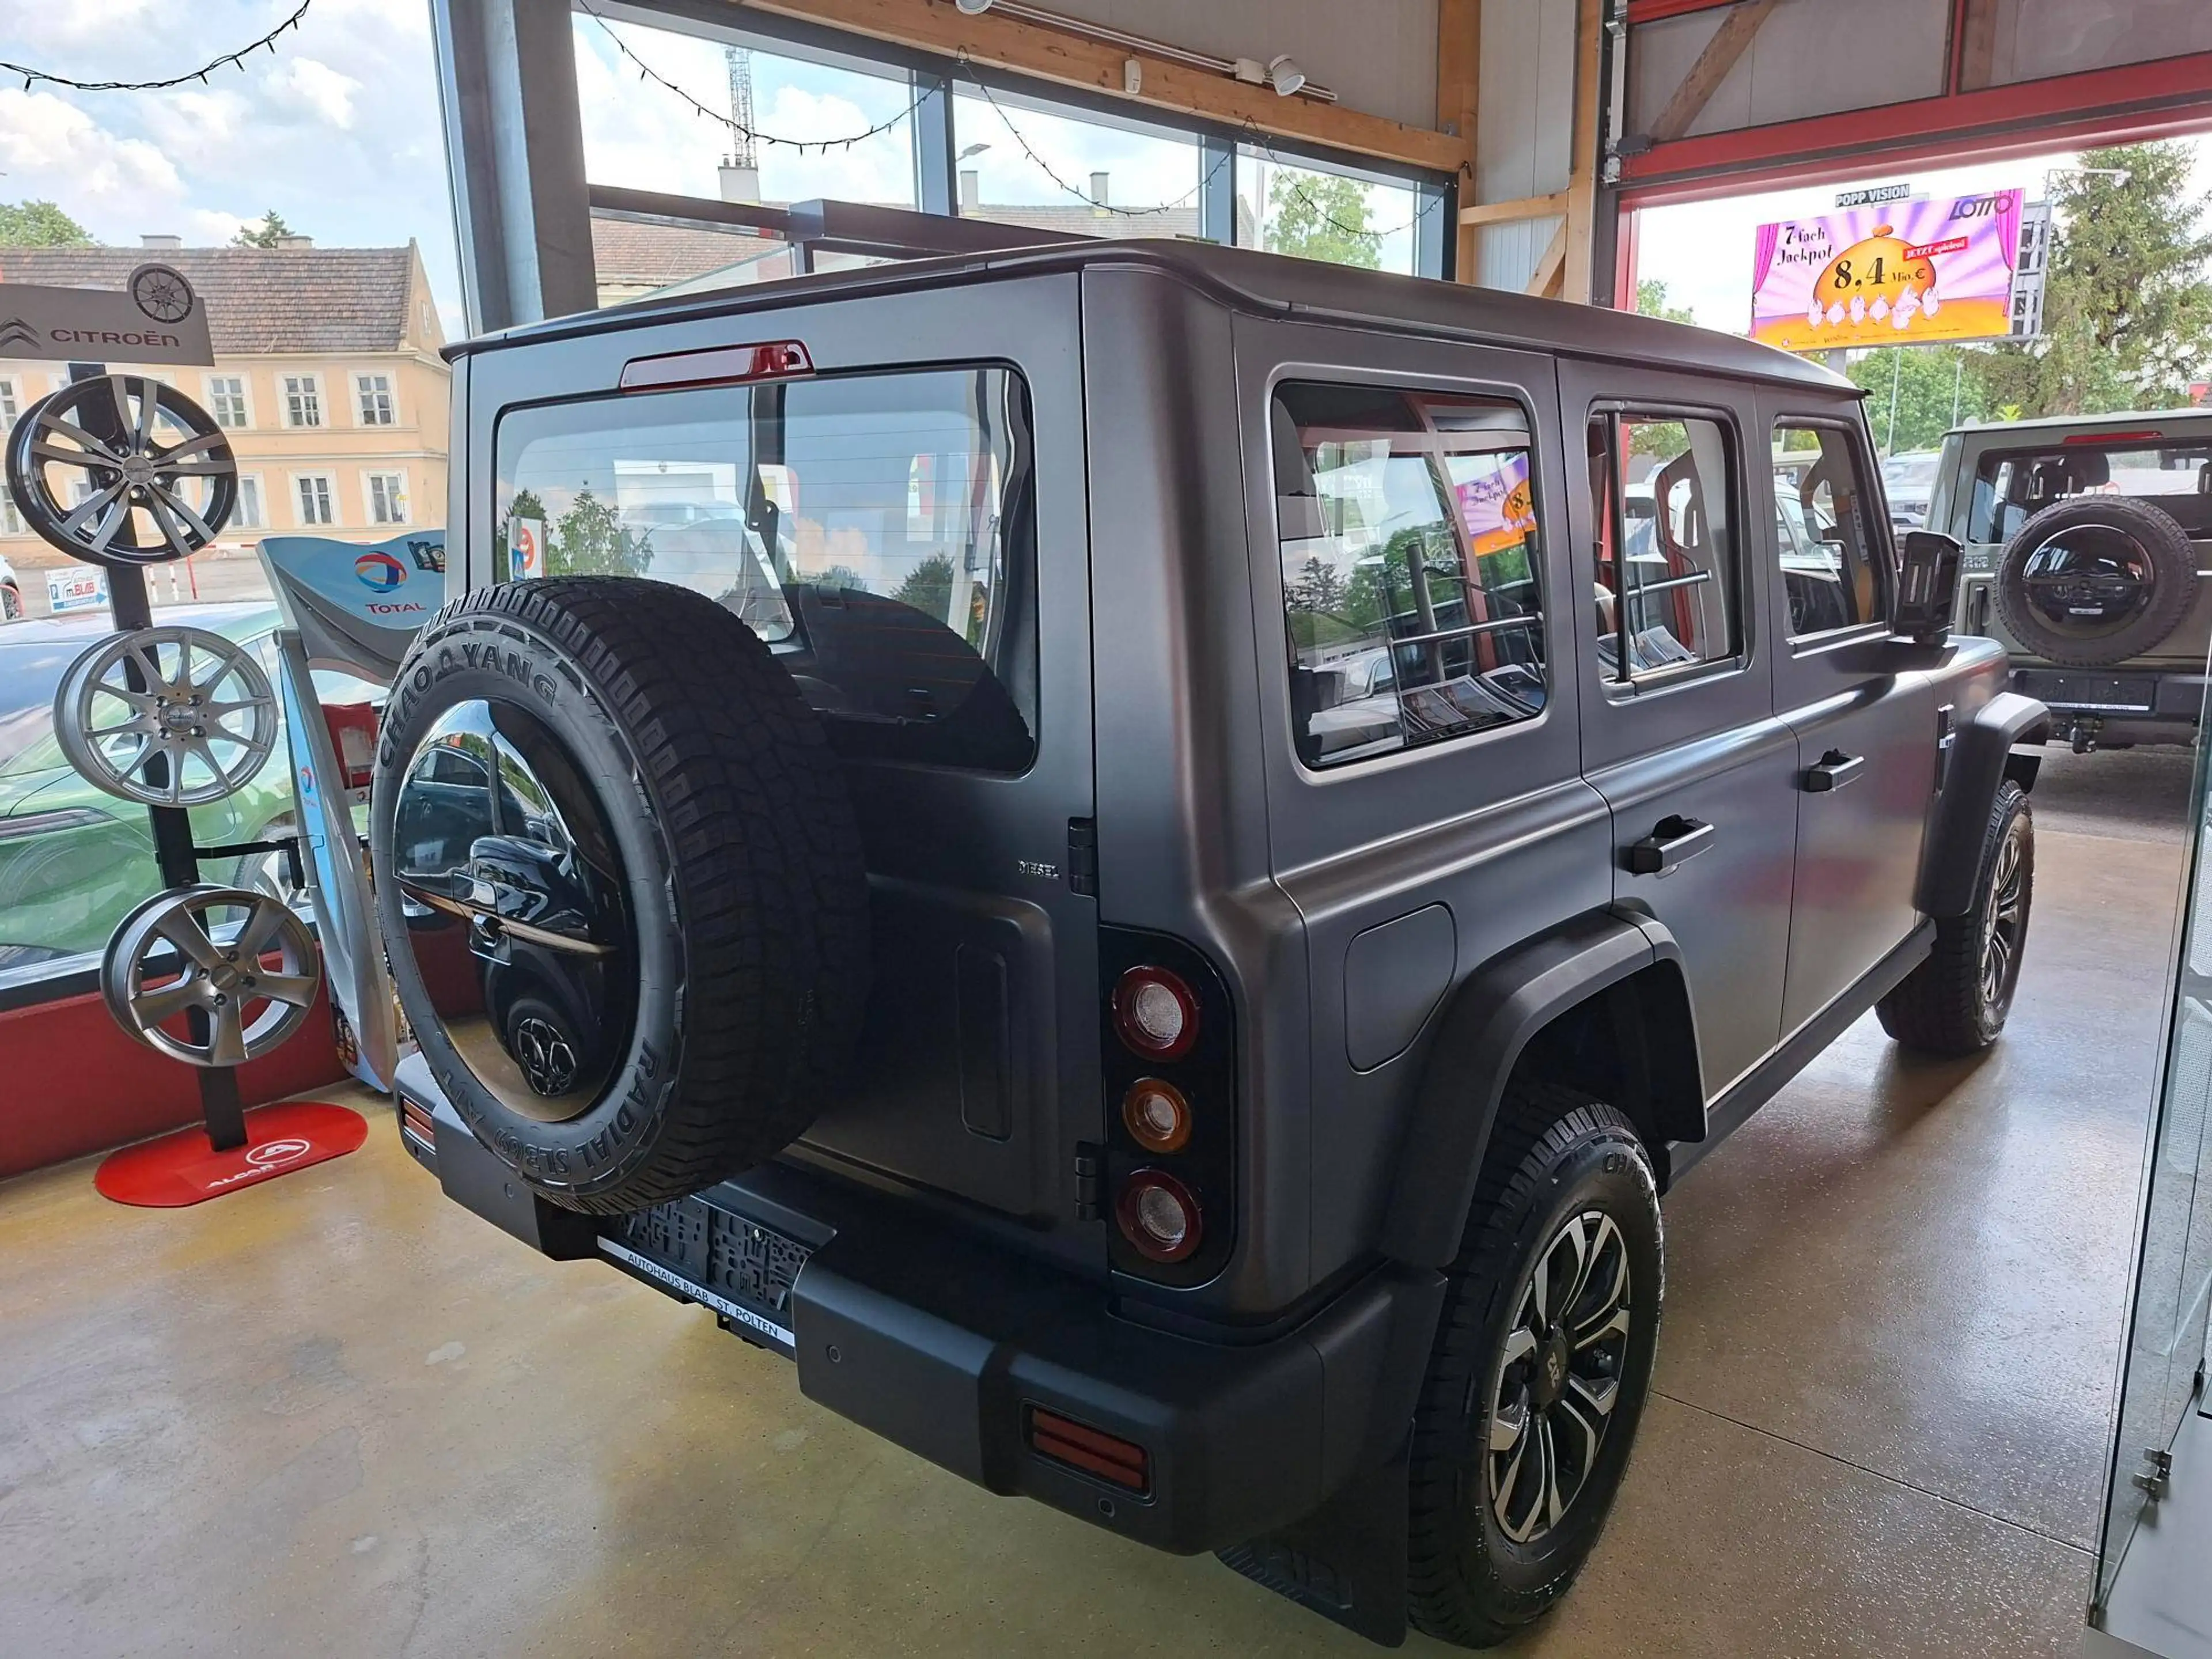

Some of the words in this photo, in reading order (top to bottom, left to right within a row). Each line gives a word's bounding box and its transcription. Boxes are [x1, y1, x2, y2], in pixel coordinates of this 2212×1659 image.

[1836, 192, 1866, 207] POPP
[1868, 185, 1908, 202] VISION
[1949, 195, 2013, 221] LOTTO
[1785, 225, 1825, 244] 7-fach
[1777, 245, 1832, 266] Jackpot
[1835, 257, 1885, 291] 8,4
[1892, 271, 1914, 282] Mio.
[365, 602, 427, 615] TOTAL
[380, 664, 432, 768] CHAO
[461, 642, 557, 707] YANG
[575, 1035, 658, 1168] RADIAL
[628, 1253, 681, 1287] AUTOHAUS
[683, 1282, 709, 1302] BLAB
